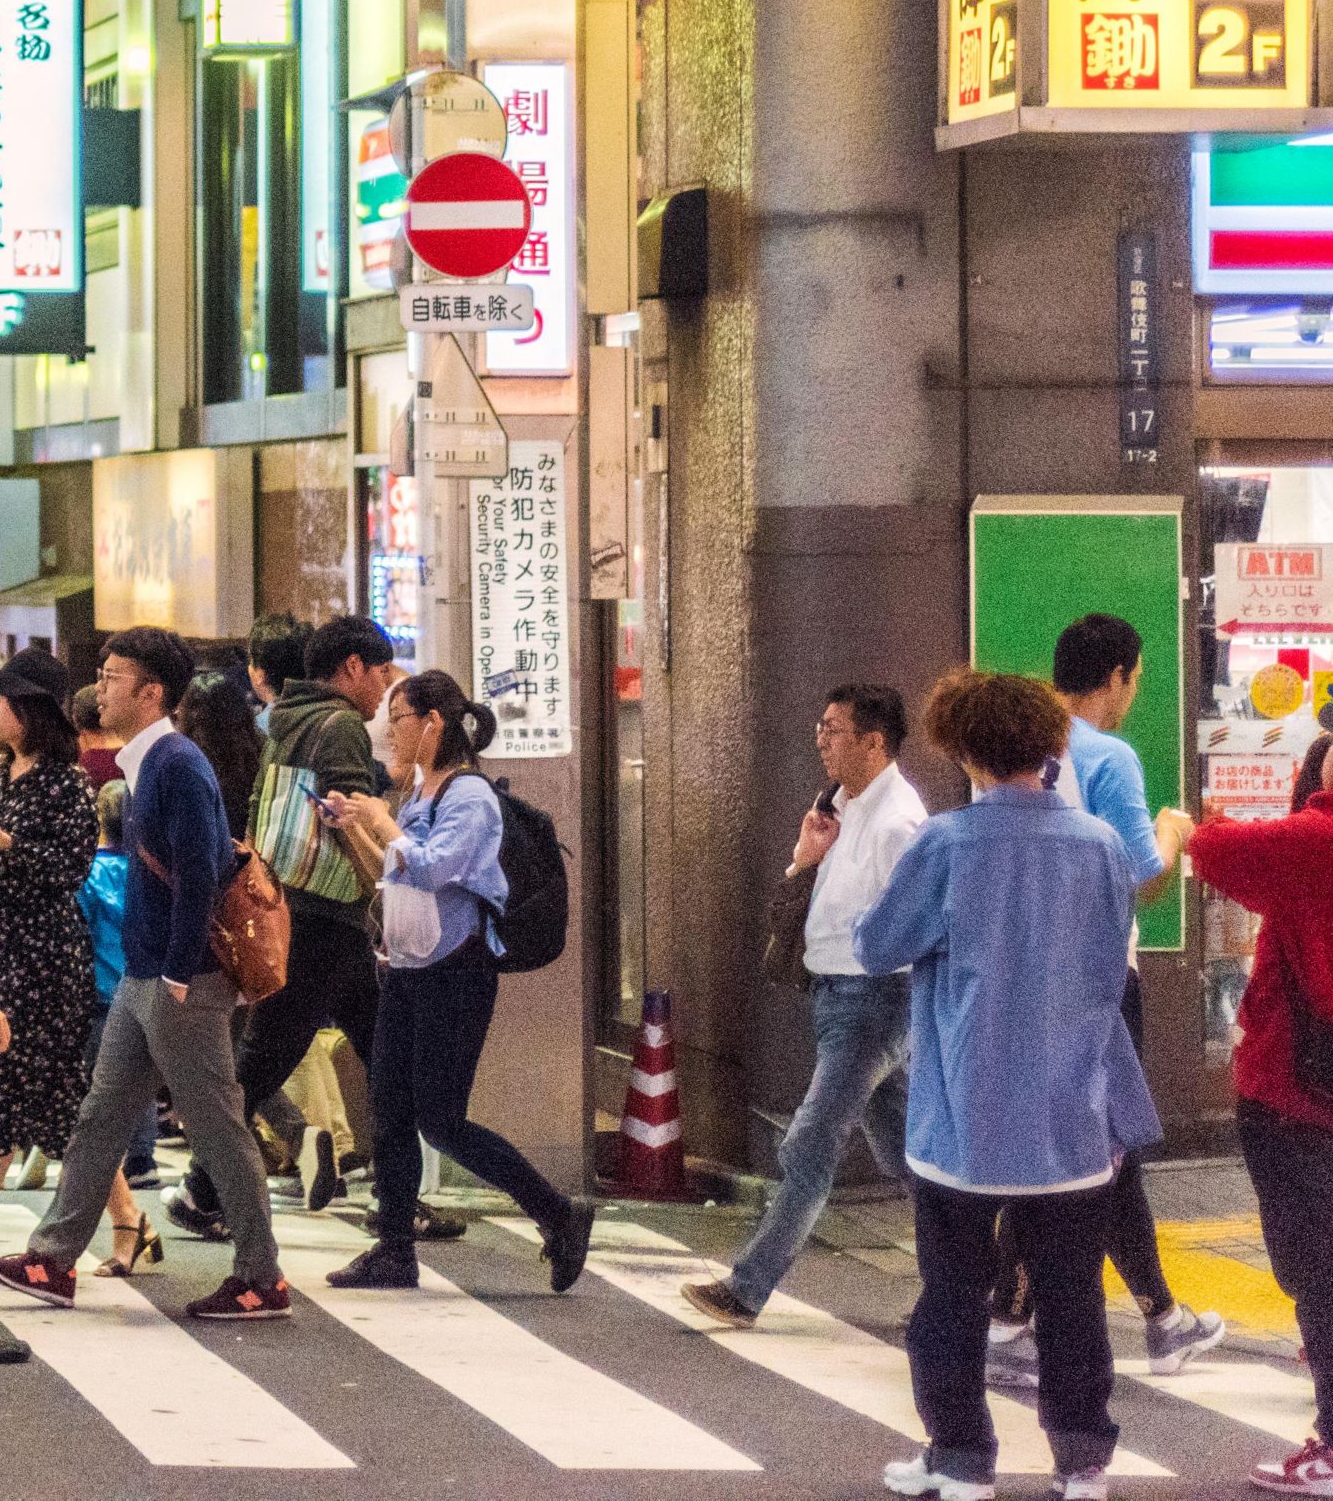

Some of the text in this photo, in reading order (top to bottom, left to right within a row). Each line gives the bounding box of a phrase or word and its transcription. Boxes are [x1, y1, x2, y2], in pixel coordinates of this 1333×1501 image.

[1196, 6, 1282, 74] 2F
[411, 294, 525, 324] 自転車を除く
[1128, 409, 1155, 433] 17
[476, 493, 490, 556] Security
[494, 498, 506, 536] Your
[494, 539, 509, 586] Safety
[509, 466, 539, 704] 防犯カメラ作動中
[536, 453, 562, 718] みなさまの安全を守ります
[1245, 551, 1315, 576] ATM
[479, 561, 491, 621] Camera
[505, 741, 547, 753] Police
